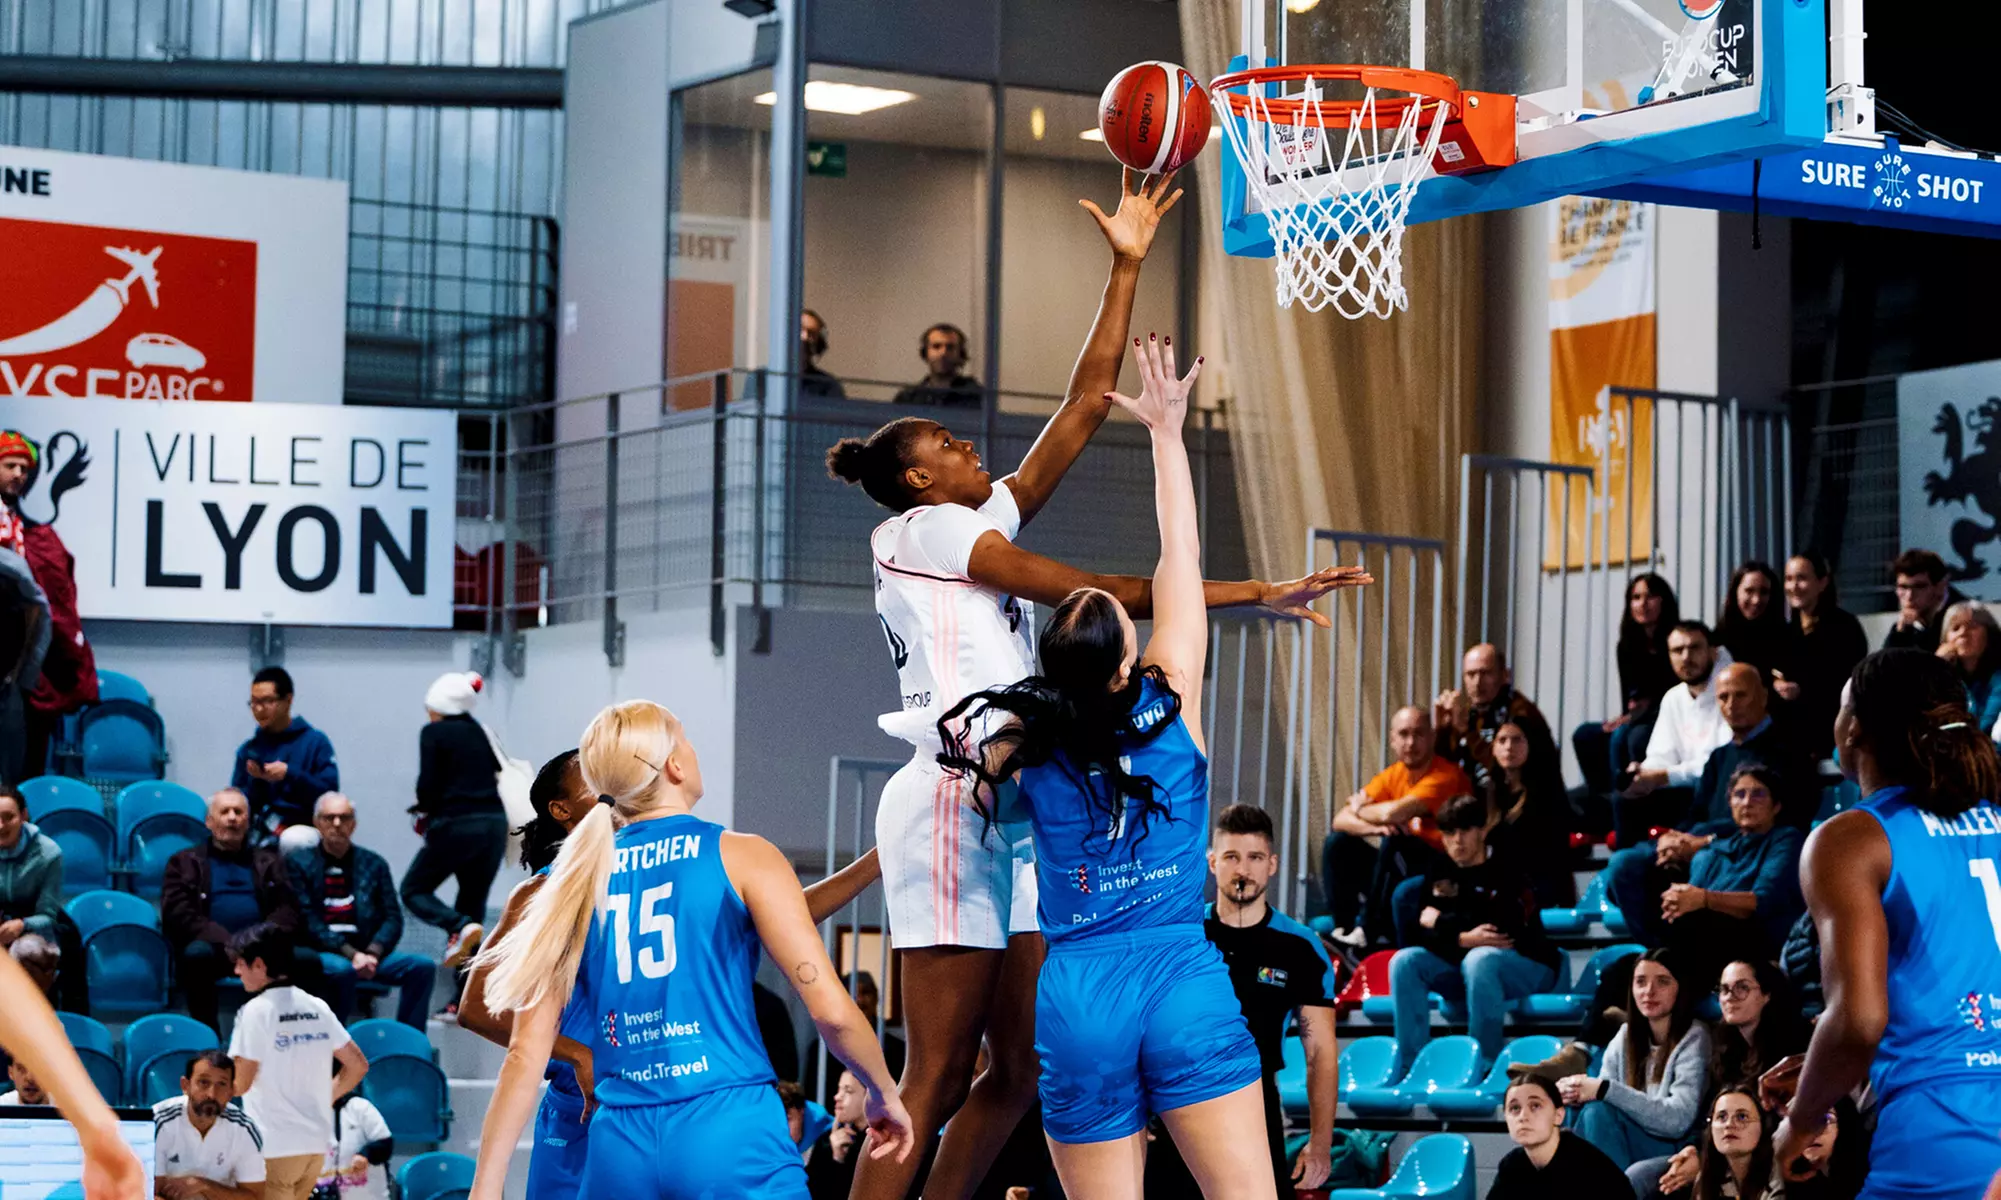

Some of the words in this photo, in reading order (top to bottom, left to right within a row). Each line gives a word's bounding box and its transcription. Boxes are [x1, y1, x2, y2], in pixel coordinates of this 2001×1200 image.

[1138, 92, 1155, 144] molten
[1874, 154, 1912, 176] SURE
[0, 166, 51, 197] NE
[1801, 159, 1866, 189] SURE
[1917, 173, 1984, 204] SHOT
[1873, 185, 1912, 208] SHOT
[146, 432, 322, 487] VILLE
[350, 439, 430, 491] DE
[145, 500, 428, 596] LYON
[612, 834, 701, 875] RTCHEN
[1098, 859, 1143, 877] Invest
[1099, 880, 1112, 892] in
[1115, 876, 1139, 888] the
[607, 881, 677, 985] 15
[624, 1007, 663, 1026] Invest
[626, 1030, 641, 1045] in
[642, 1027, 660, 1042] the
[662, 1020, 701, 1038] West
[621, 1055, 709, 1082] land.Travel
